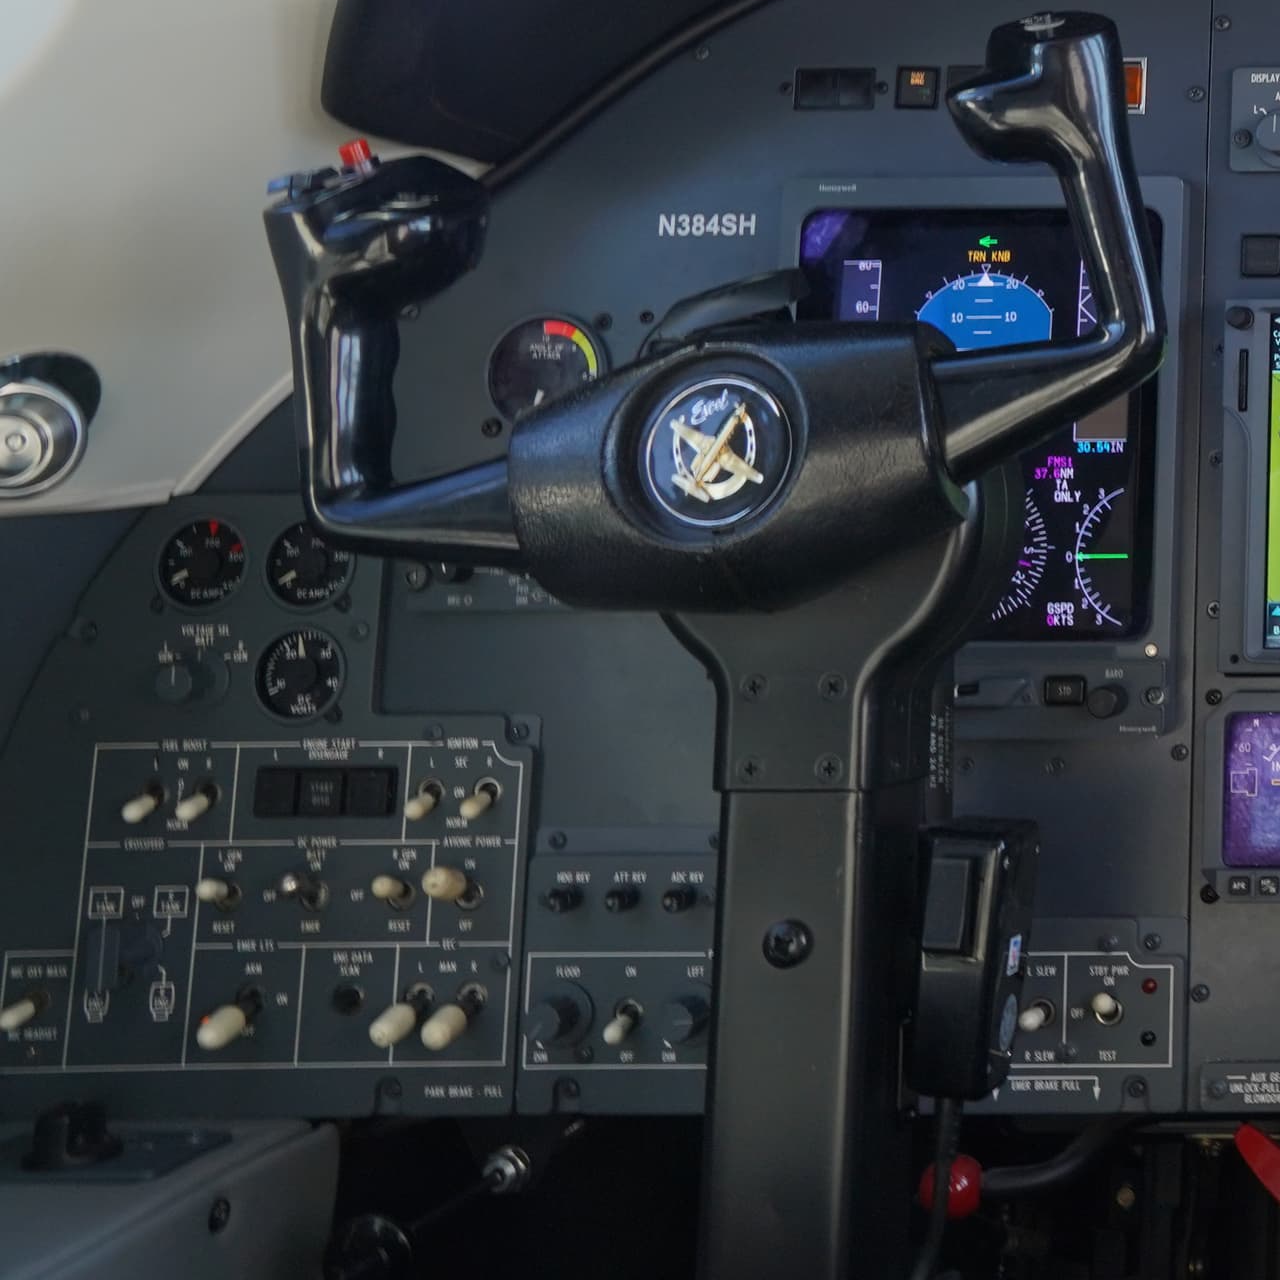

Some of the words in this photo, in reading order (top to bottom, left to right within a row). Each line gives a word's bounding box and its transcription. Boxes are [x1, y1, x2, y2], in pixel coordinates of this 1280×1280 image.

[1251, 74, 1280, 83] DISPLAY
[658, 213, 756, 237] N384SH
[689, 389, 729, 426] Excel
